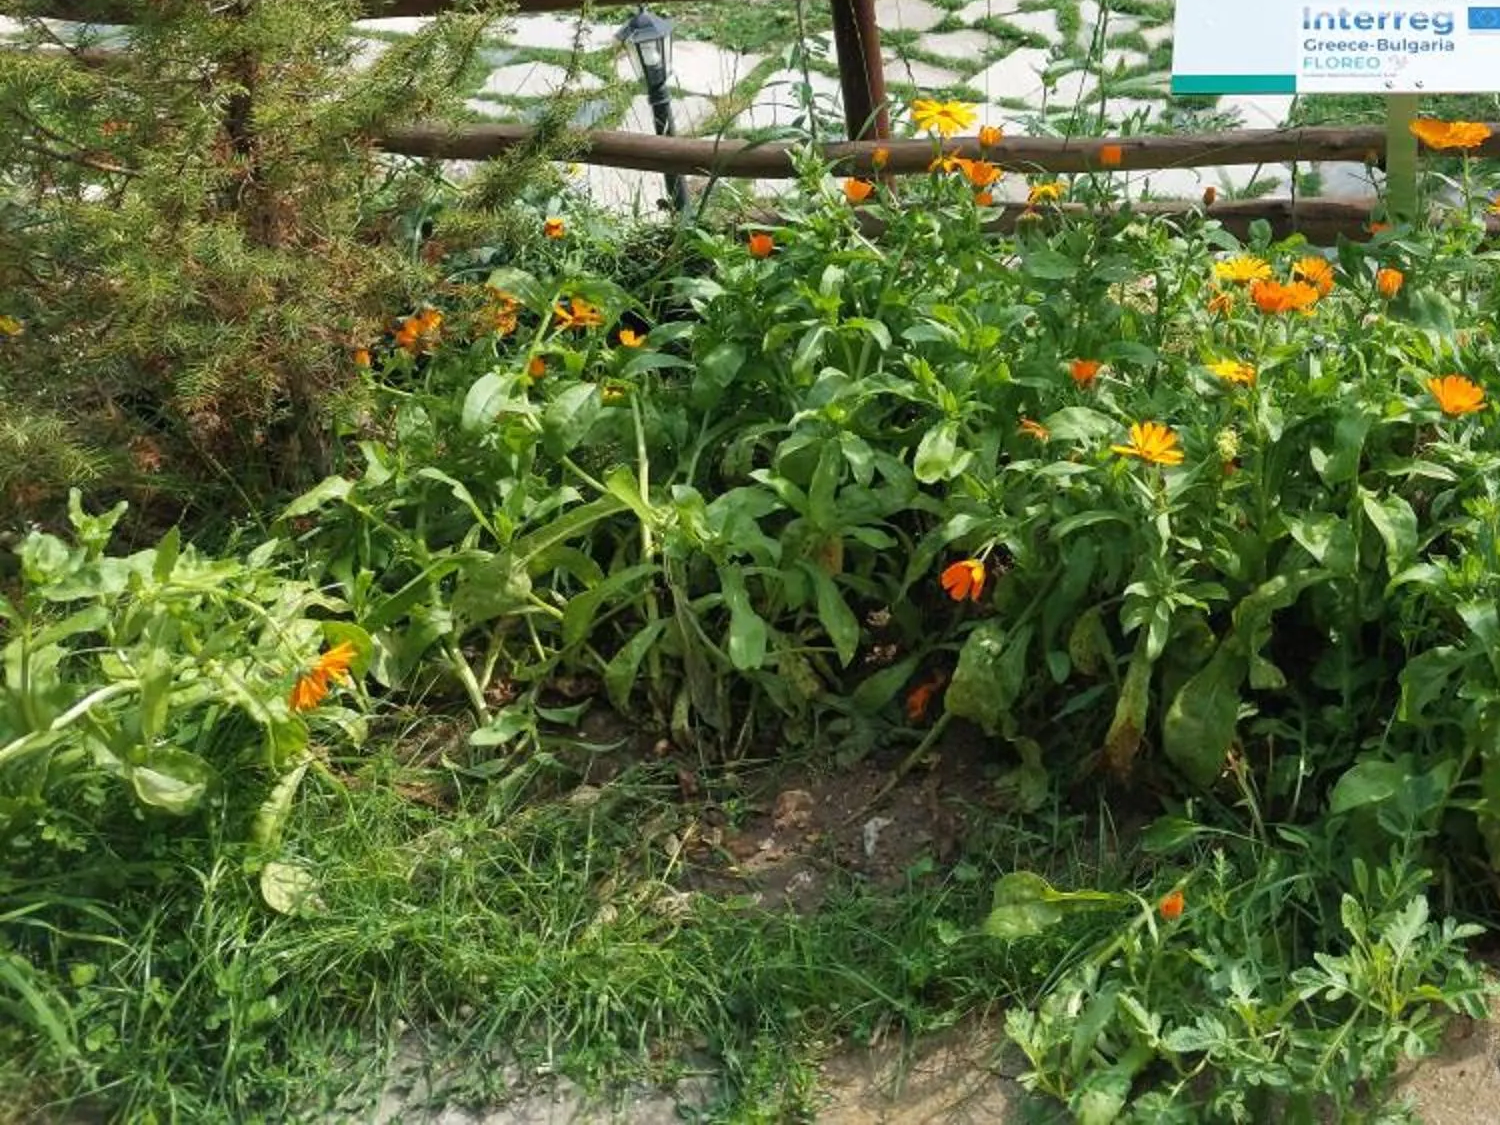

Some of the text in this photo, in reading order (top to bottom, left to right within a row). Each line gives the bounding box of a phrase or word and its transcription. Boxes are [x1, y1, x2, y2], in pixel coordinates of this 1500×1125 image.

[1303, 7, 1455, 35] Interreg
[1303, 38, 1455, 54] Greece-Bulgaria
[1303, 56, 1381, 70] FLOREO
